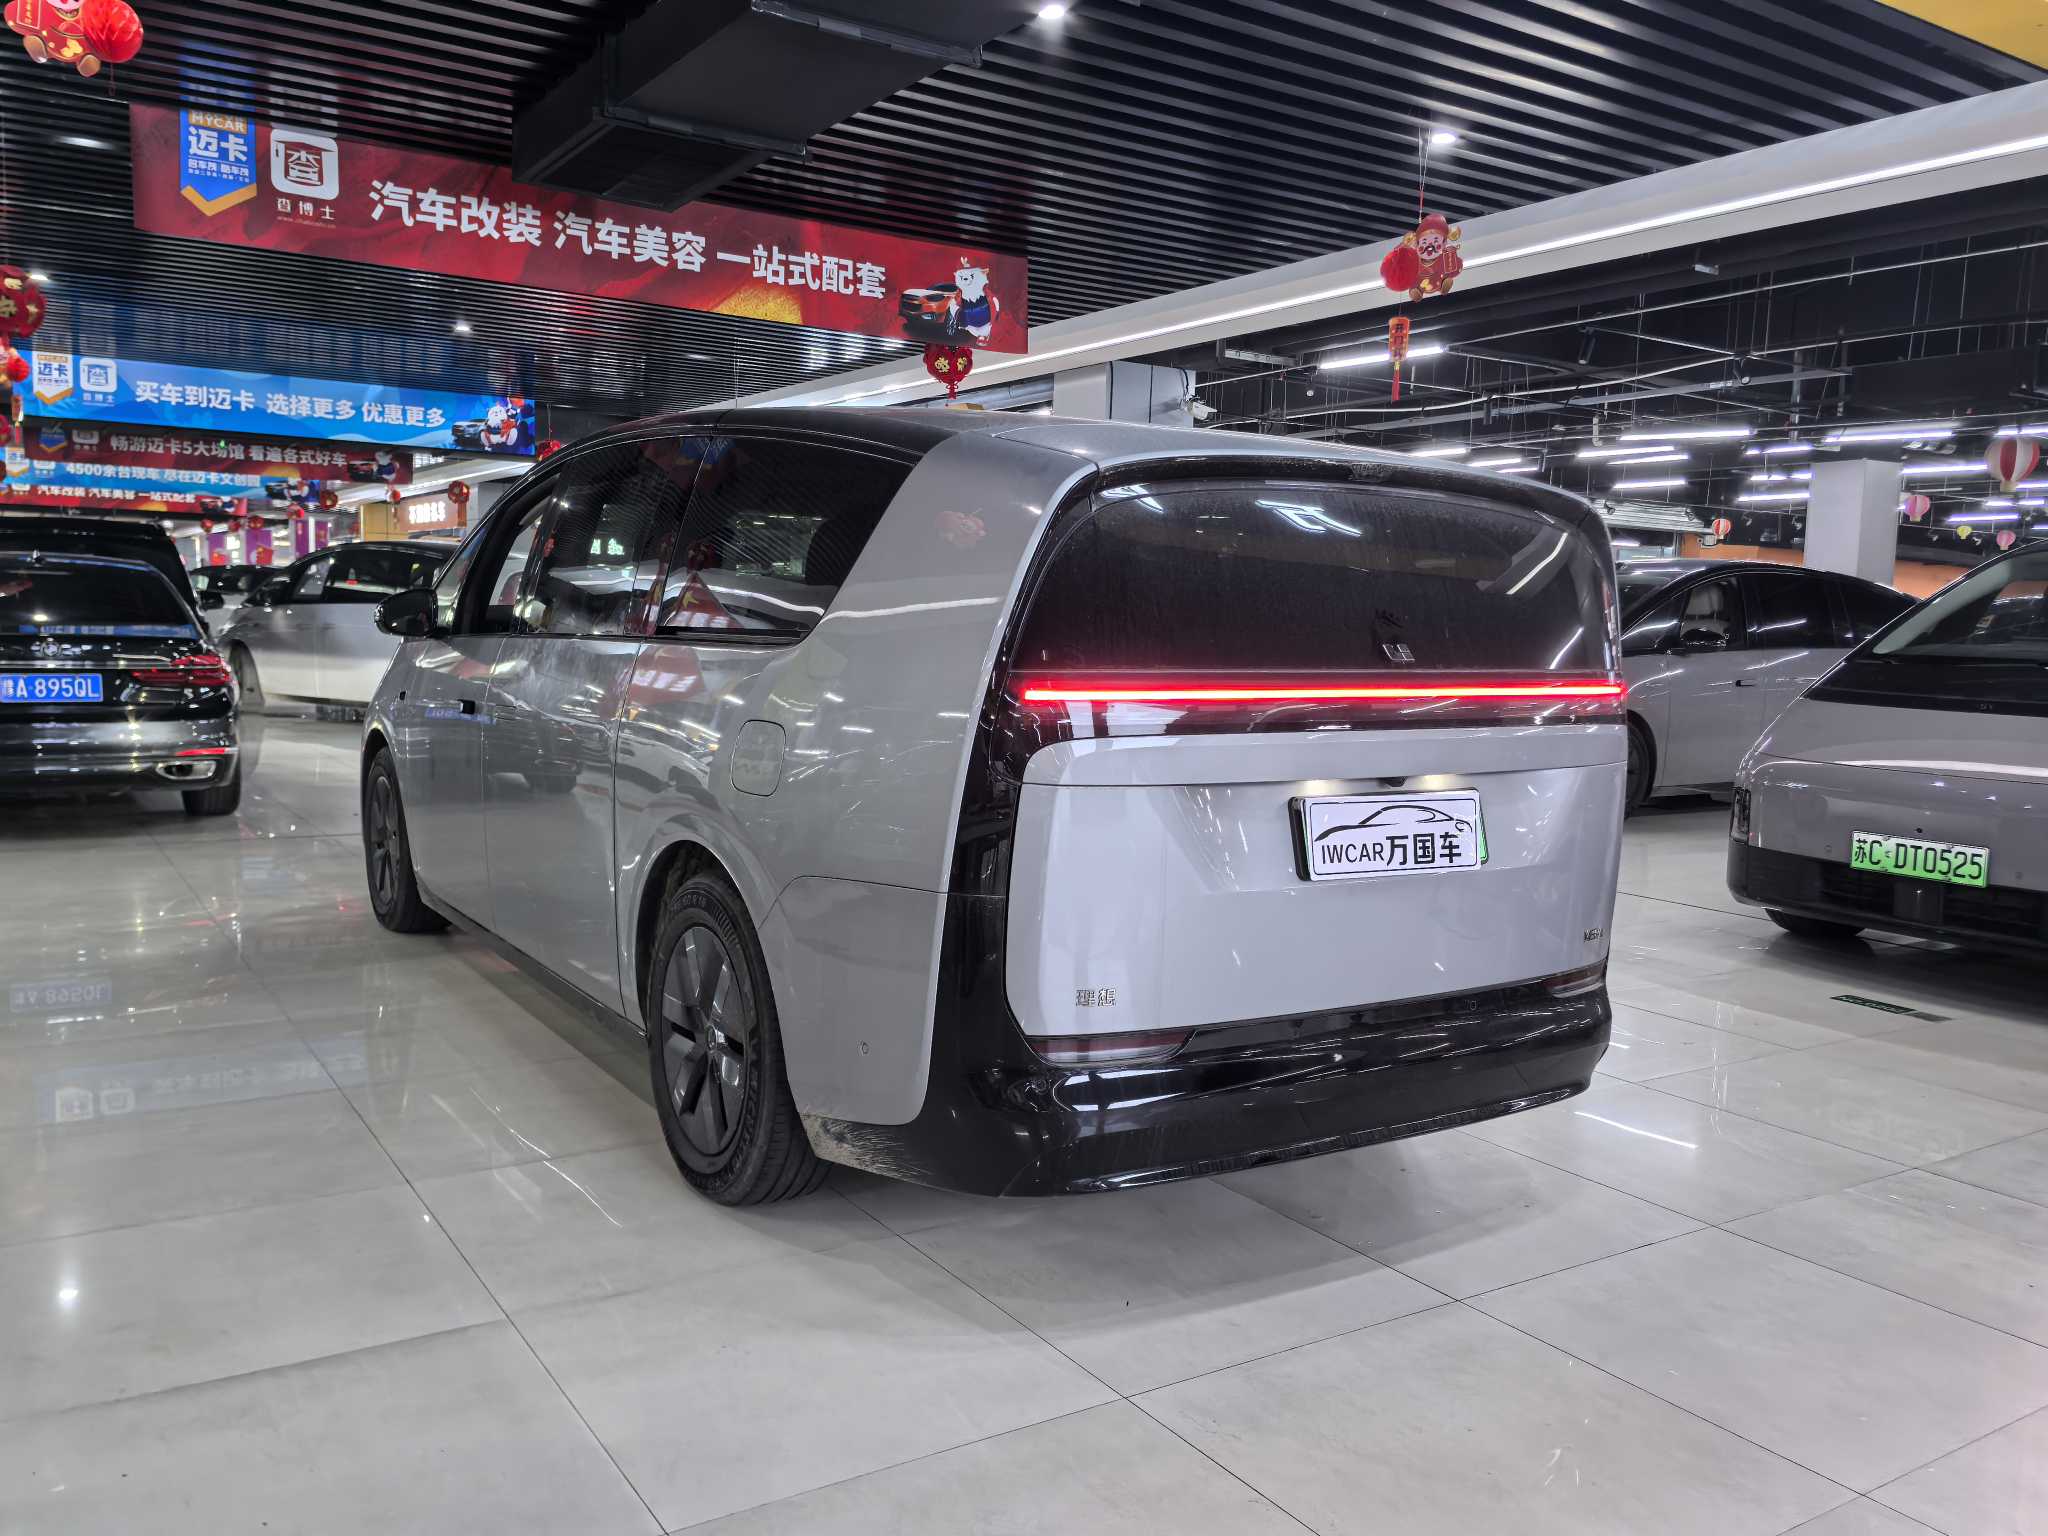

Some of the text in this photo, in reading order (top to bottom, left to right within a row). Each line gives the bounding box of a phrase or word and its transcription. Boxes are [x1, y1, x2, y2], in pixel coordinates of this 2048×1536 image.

[188, 126, 248, 162] 迈卡
[369, 179, 886, 299] 汽车改装 汽车美容 一站式配套
[136, 380, 446, 428] 买车到迈卡 选择更多 优惠更多
[110, 434, 245, 460] 畅游迈卡5大场馆
